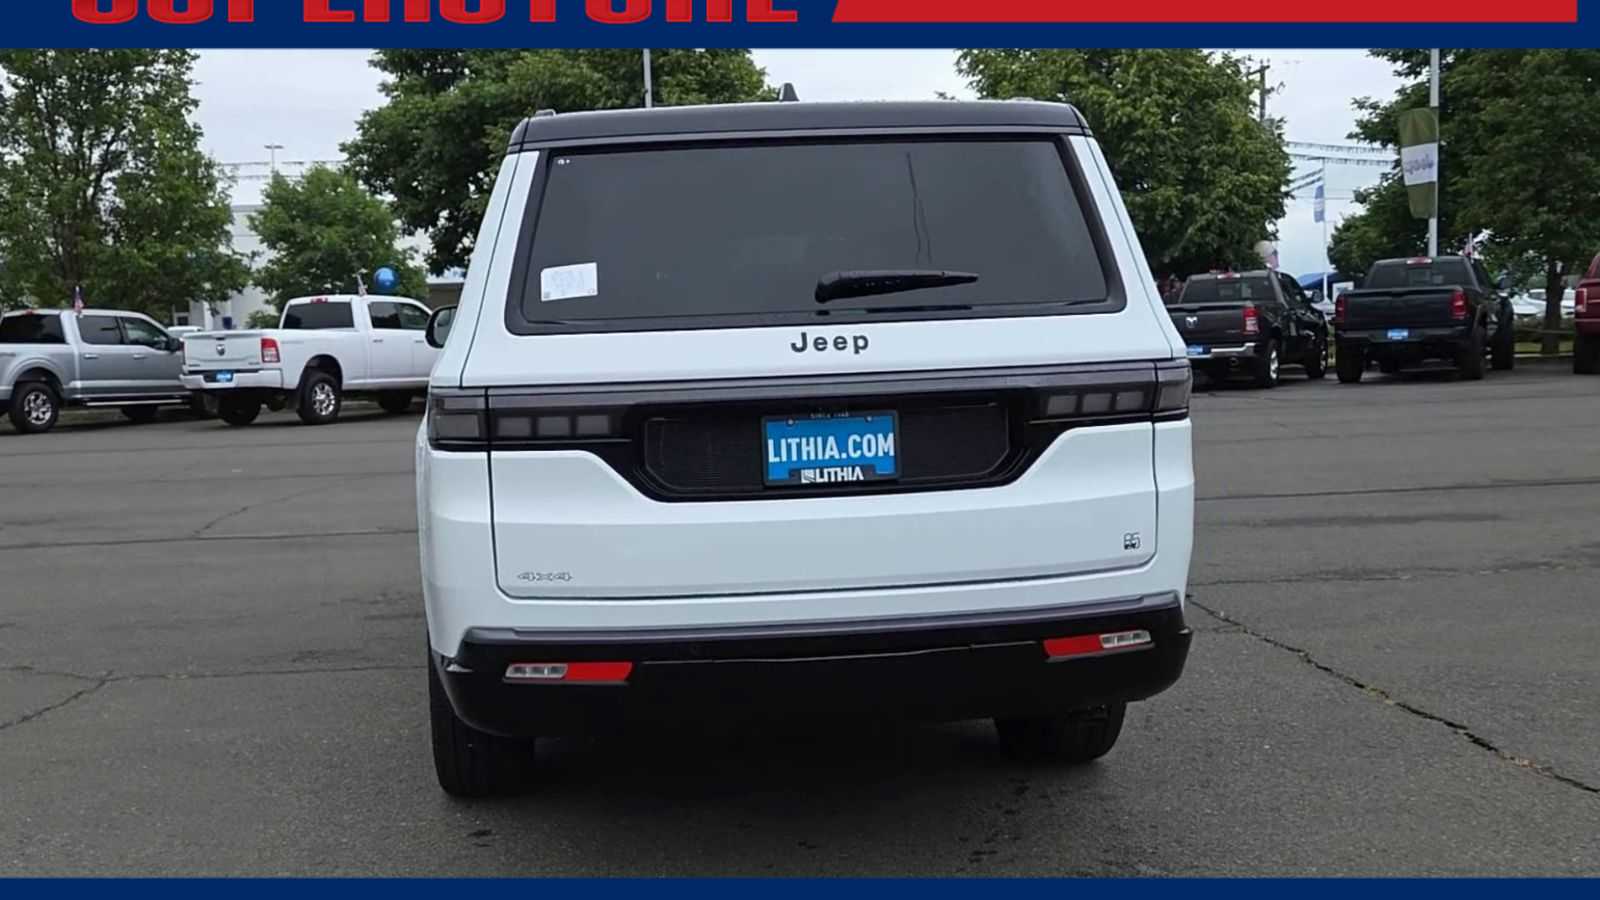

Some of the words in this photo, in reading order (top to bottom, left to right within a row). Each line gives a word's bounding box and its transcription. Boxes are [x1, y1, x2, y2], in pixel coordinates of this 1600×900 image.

[790, 332, 869, 354] Jeep
[768, 433, 895, 463] LITHIA.COM
[815, 466, 864, 483] LITHIA
